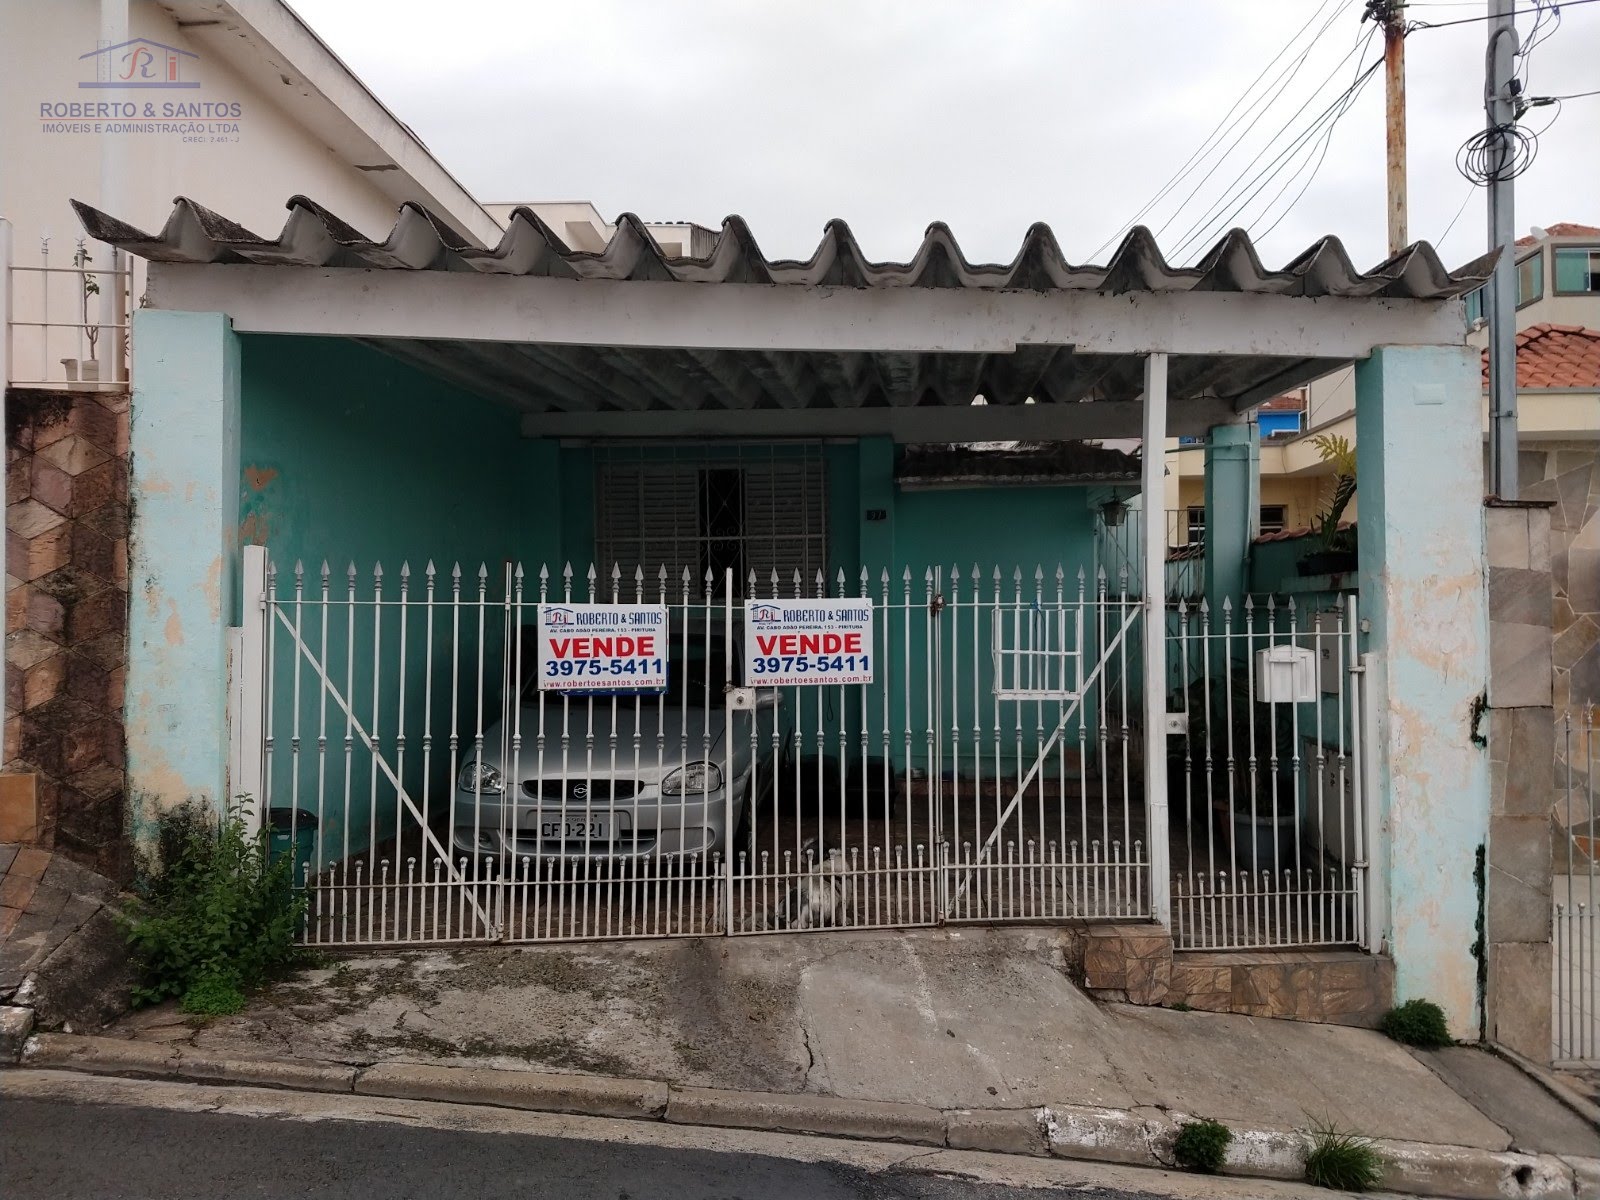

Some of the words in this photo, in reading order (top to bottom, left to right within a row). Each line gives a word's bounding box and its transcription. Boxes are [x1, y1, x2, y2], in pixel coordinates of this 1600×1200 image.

[576, 612, 619, 625] ROBERTO
[621, 613, 627, 624] &
[628, 612, 662, 625] SANTOS
[783, 609, 826, 622] ROBERTO
[828, 611, 834, 620] &
[836, 608, 869, 622] SANTOS
[549, 636, 655, 659] VENDE
[756, 633, 862, 656] VENDE
[545, 658, 662, 677] 3975-5411
[752, 655, 869, 674] 3975-5411
